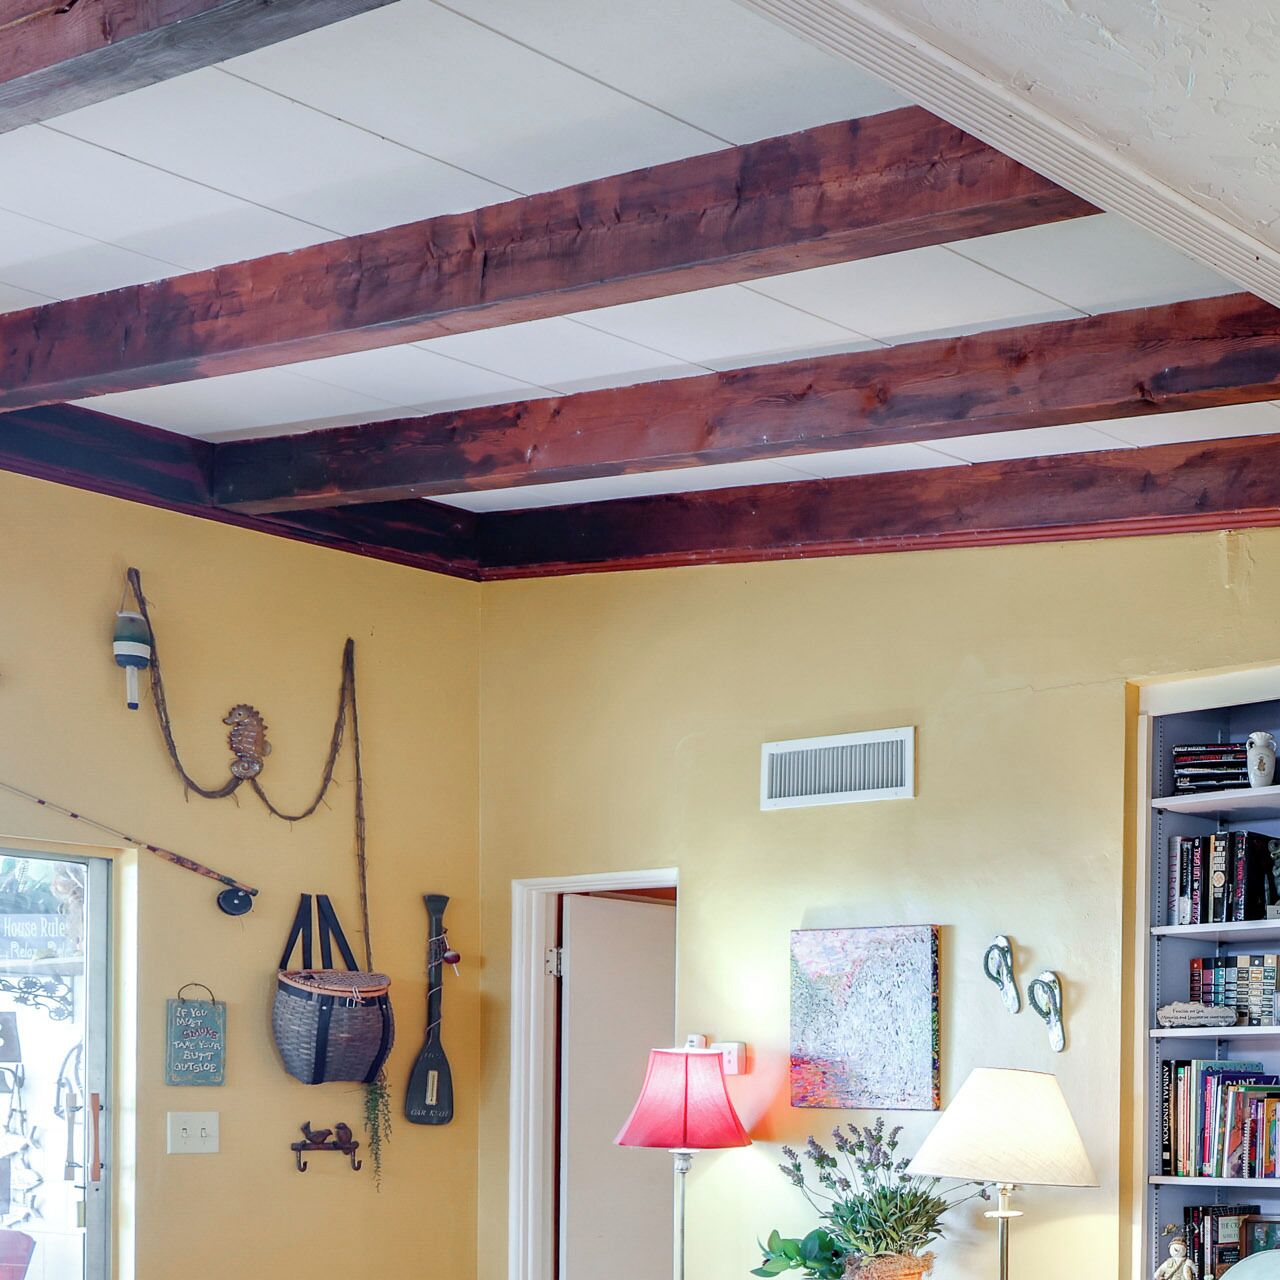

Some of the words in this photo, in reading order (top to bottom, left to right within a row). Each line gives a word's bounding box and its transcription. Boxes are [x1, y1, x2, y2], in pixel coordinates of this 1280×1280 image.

[1169, 853, 1178, 913] TUROW
[4, 917, 37, 937] House
[176, 1008, 188, 1017] IF
[191, 1008, 208, 1017] YOU
[176, 1018, 202, 1027] MUST
[183, 1051, 214, 1061] BUTT
[174, 1062, 217, 1073] OUTSIDE
